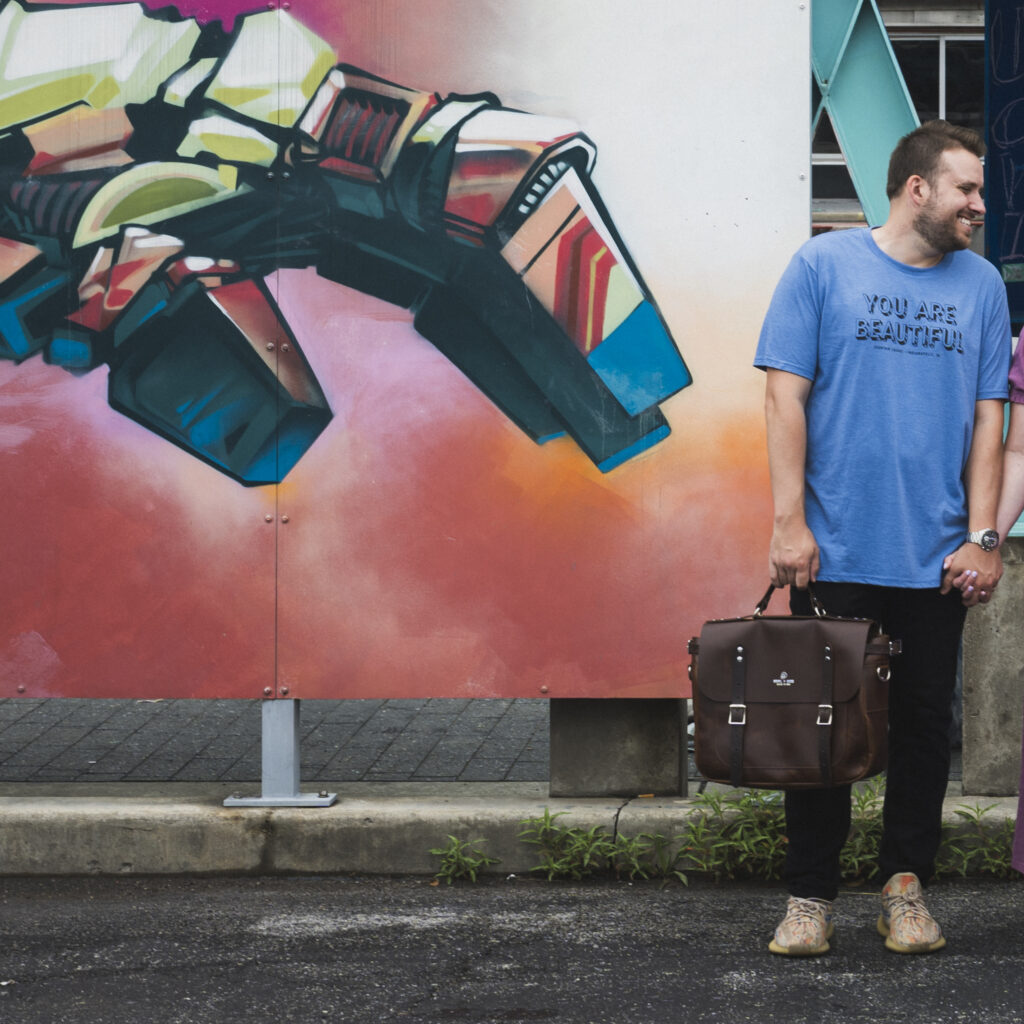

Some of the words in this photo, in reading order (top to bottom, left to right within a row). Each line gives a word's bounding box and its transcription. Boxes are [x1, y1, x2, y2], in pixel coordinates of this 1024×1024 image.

[863, 293, 908, 319] YOU
[914, 301, 958, 326] ARE
[855, 318, 964, 355] BEAUTIFUL
